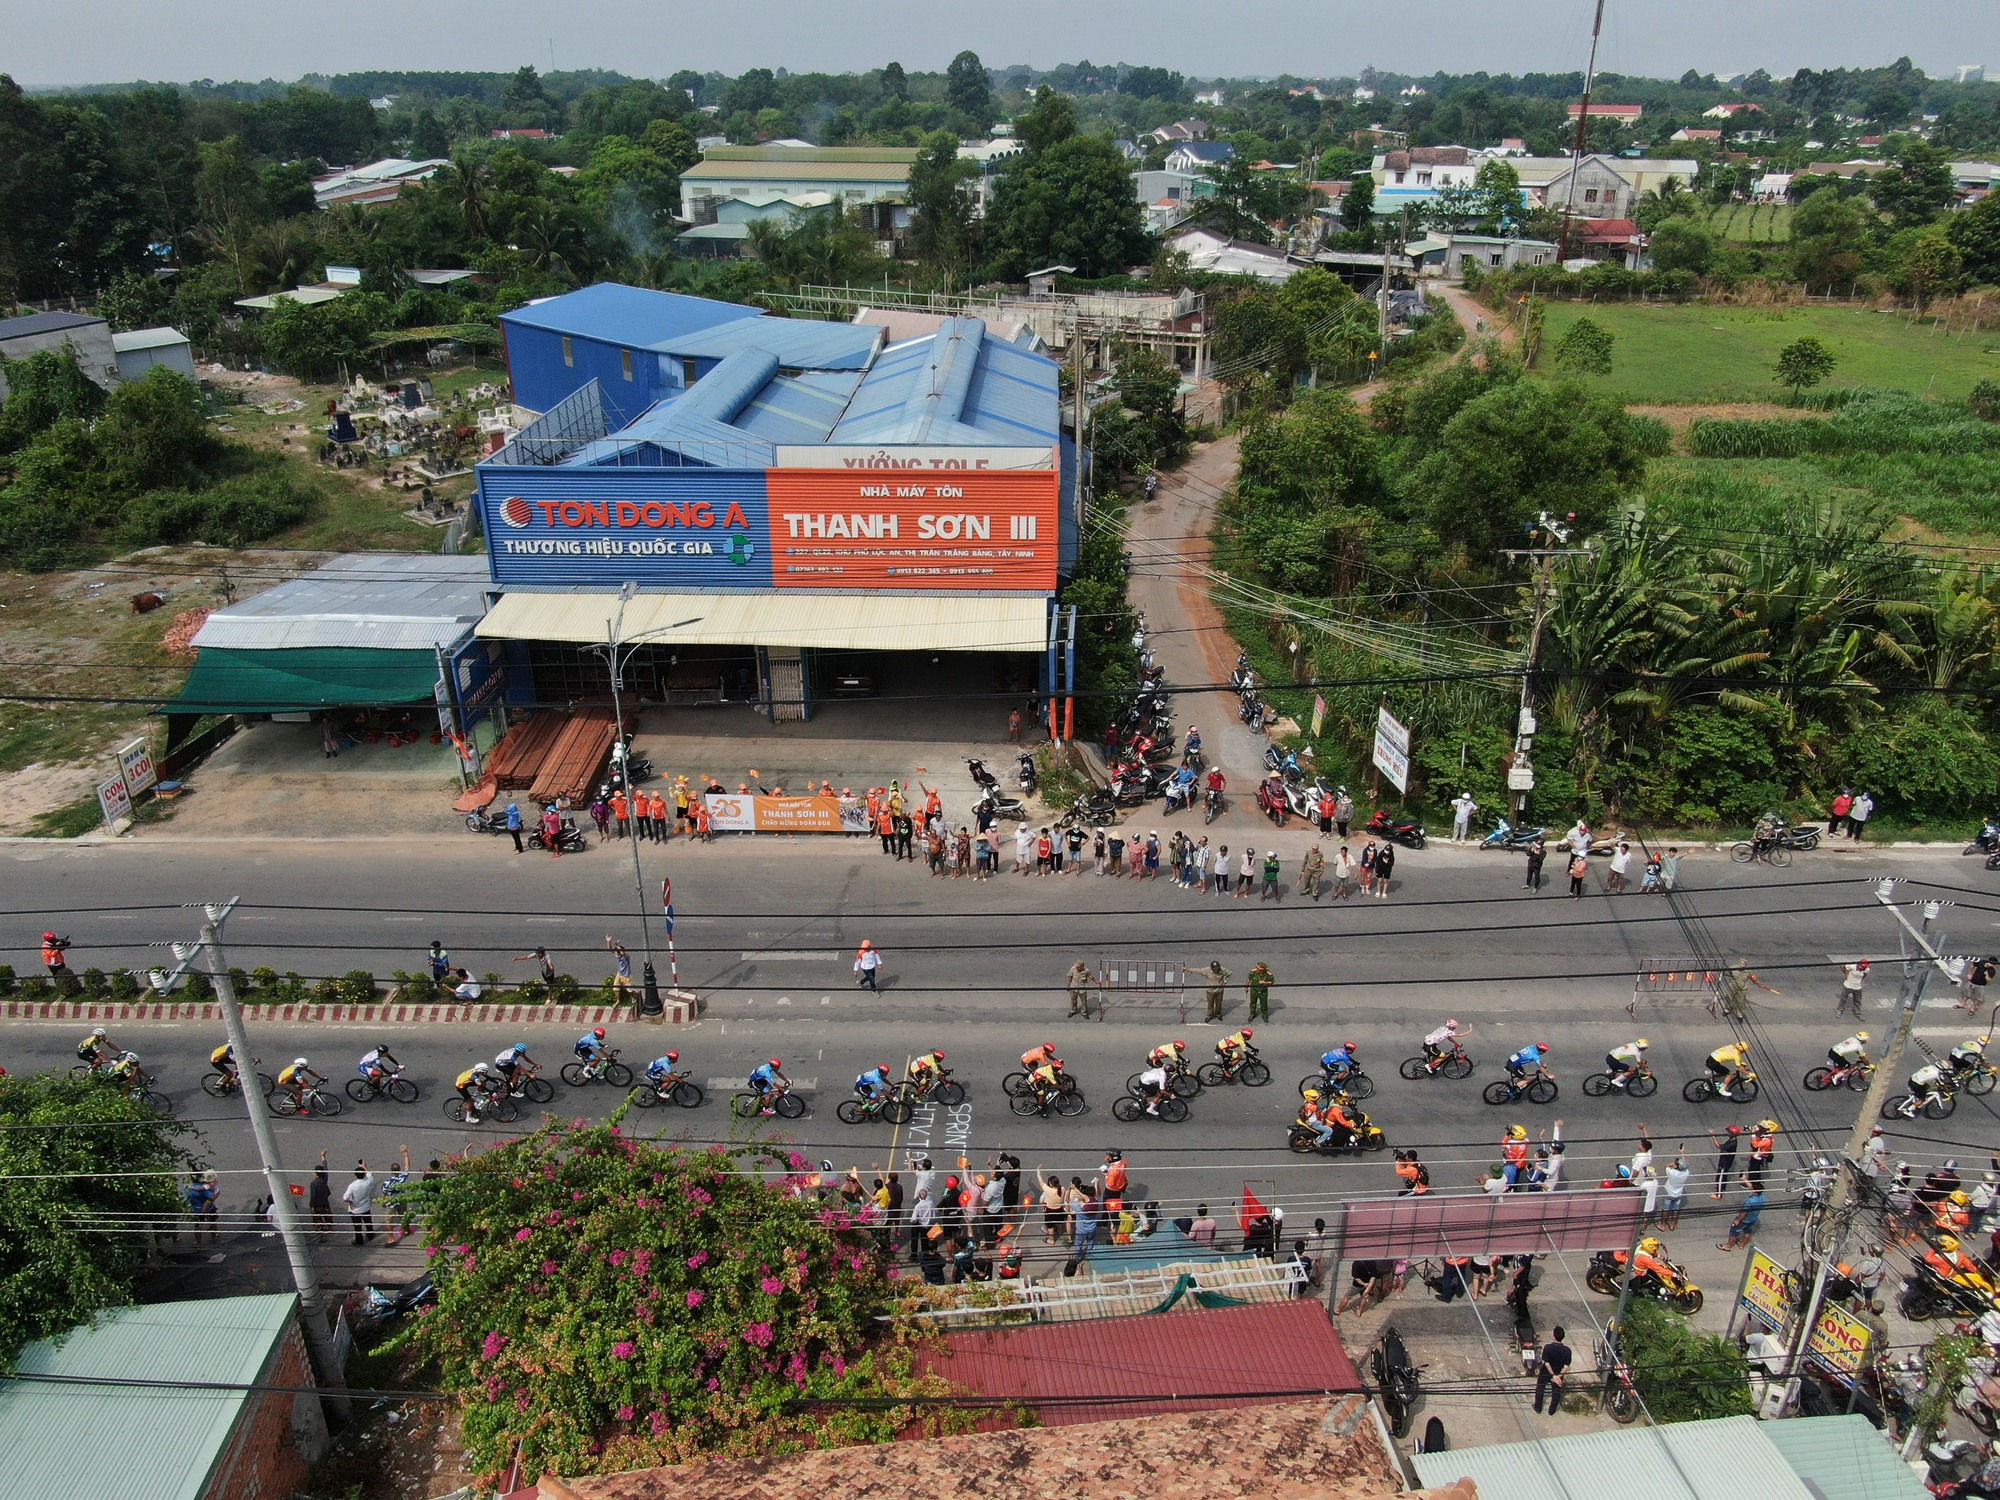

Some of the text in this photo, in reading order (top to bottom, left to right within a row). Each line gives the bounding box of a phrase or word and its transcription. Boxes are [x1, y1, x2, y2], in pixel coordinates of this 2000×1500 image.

[860, 484, 963, 497] NHÀ MÁY TÔN
[536, 500, 749, 528] TON DONG A
[783, 513, 1037, 540] THANH SƠN III
[504, 537, 713, 559] THƯƠNG HIỆU QUỐC GIA
[997, 549, 1012, 557] TÂY
[762, 809, 828, 818] THANH SƠN III
